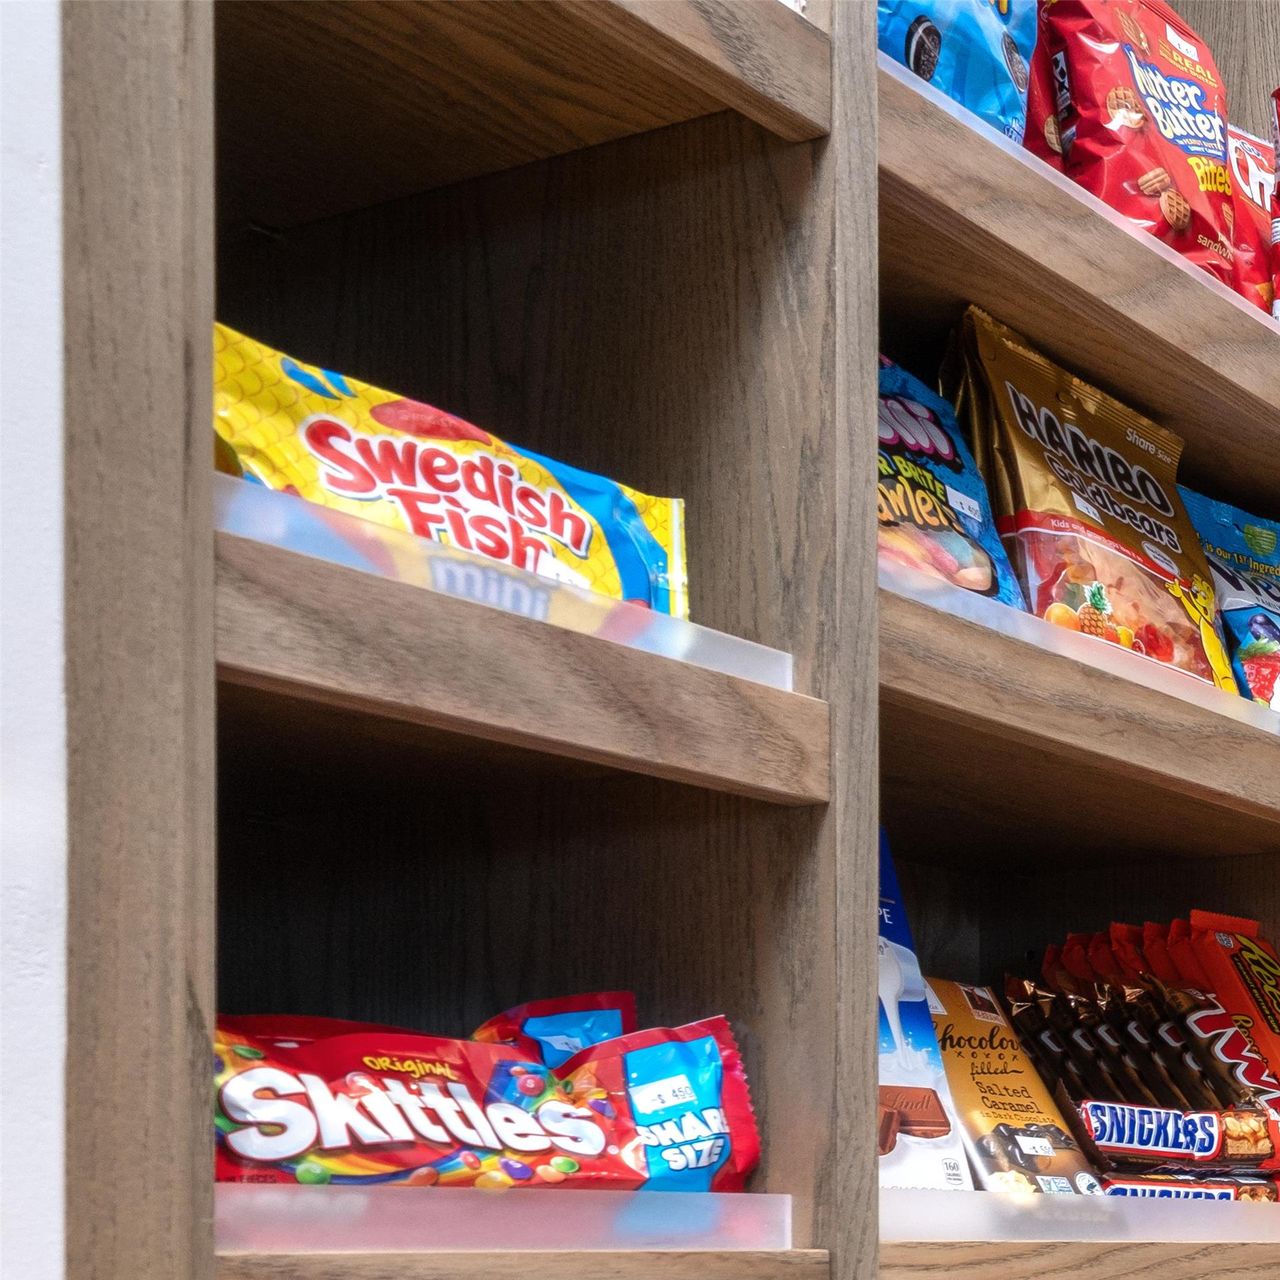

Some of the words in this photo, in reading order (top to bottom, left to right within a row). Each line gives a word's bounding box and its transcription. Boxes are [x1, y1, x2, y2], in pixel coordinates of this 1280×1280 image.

[1173, 52, 1216, 82] REAL
[1187, 157, 1232, 196] Bites
[1005, 381, 1175, 518] HARIBO
[1125, 428, 1156, 453] Share
[1156, 447, 1172, 464] Size
[306, 416, 590, 555] Swedish
[387, 488, 556, 574] Fish
[427, 558, 553, 620] mini
[970, 1061, 1024, 1082] filled
[976, 1081, 1031, 1099] Salted
[982, 1096, 1043, 1115] Caramel
[222, 1067, 608, 1160] Skittles
[993, 1112, 1013, 1121] Dark
[1089, 1103, 1216, 1155] SNICKERS
[661, 1138, 724, 1171] SIZE
[944, 1160, 959, 1173] 160
